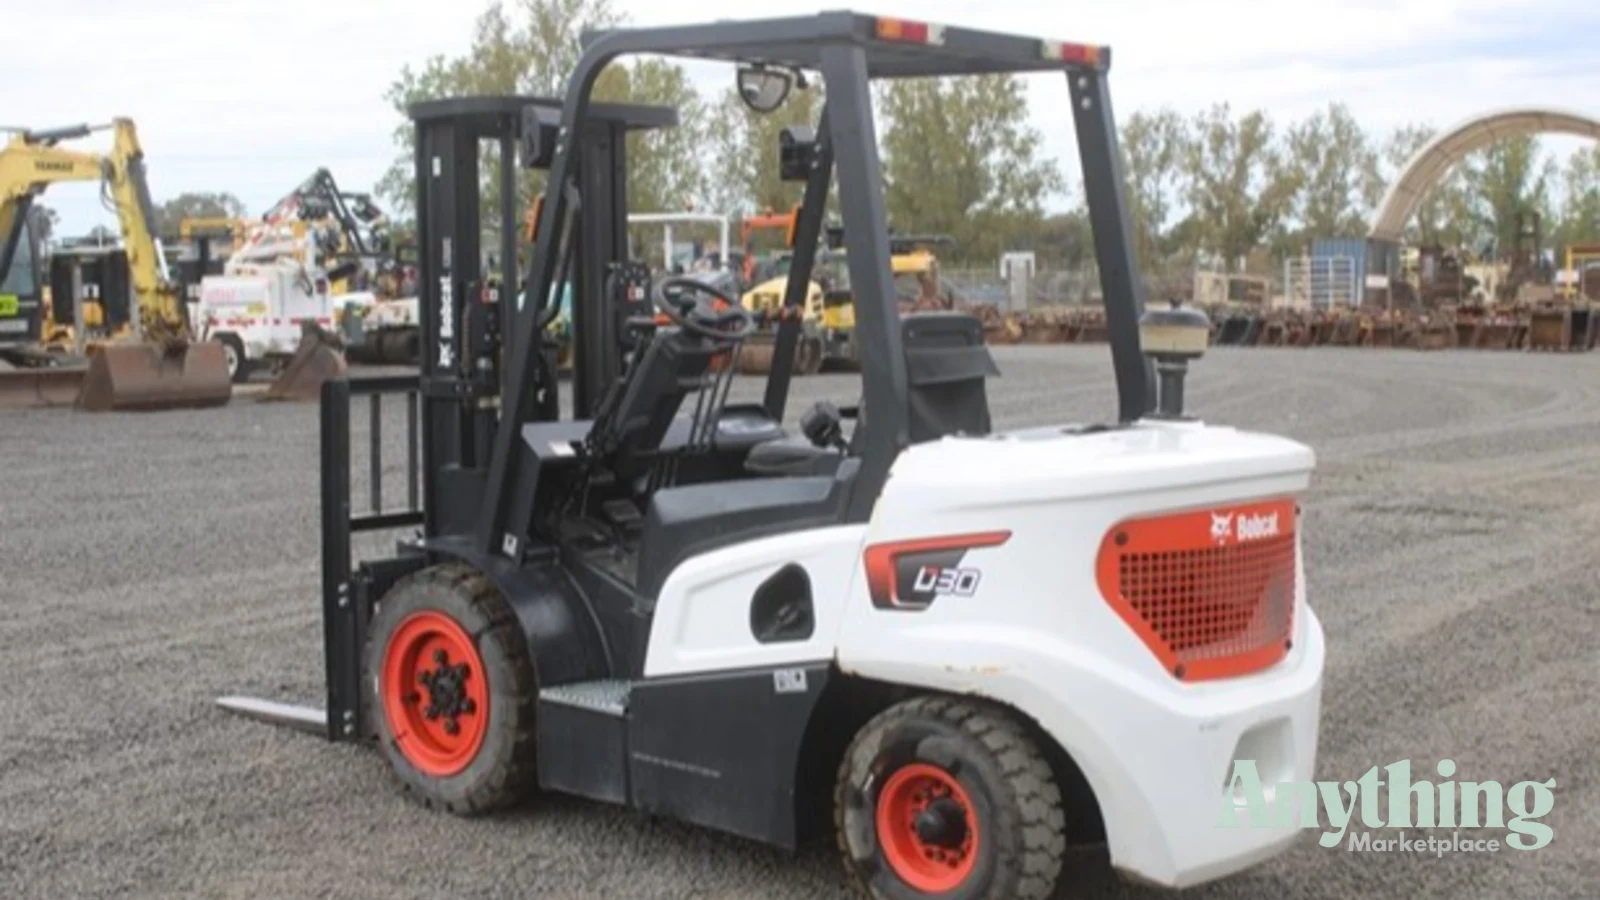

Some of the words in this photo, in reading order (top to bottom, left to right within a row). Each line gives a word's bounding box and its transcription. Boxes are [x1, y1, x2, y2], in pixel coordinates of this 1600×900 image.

[440, 276, 453, 338] Bobcat
[1236, 512, 1278, 540] Bobcat
[913, 565, 979, 596] D30
